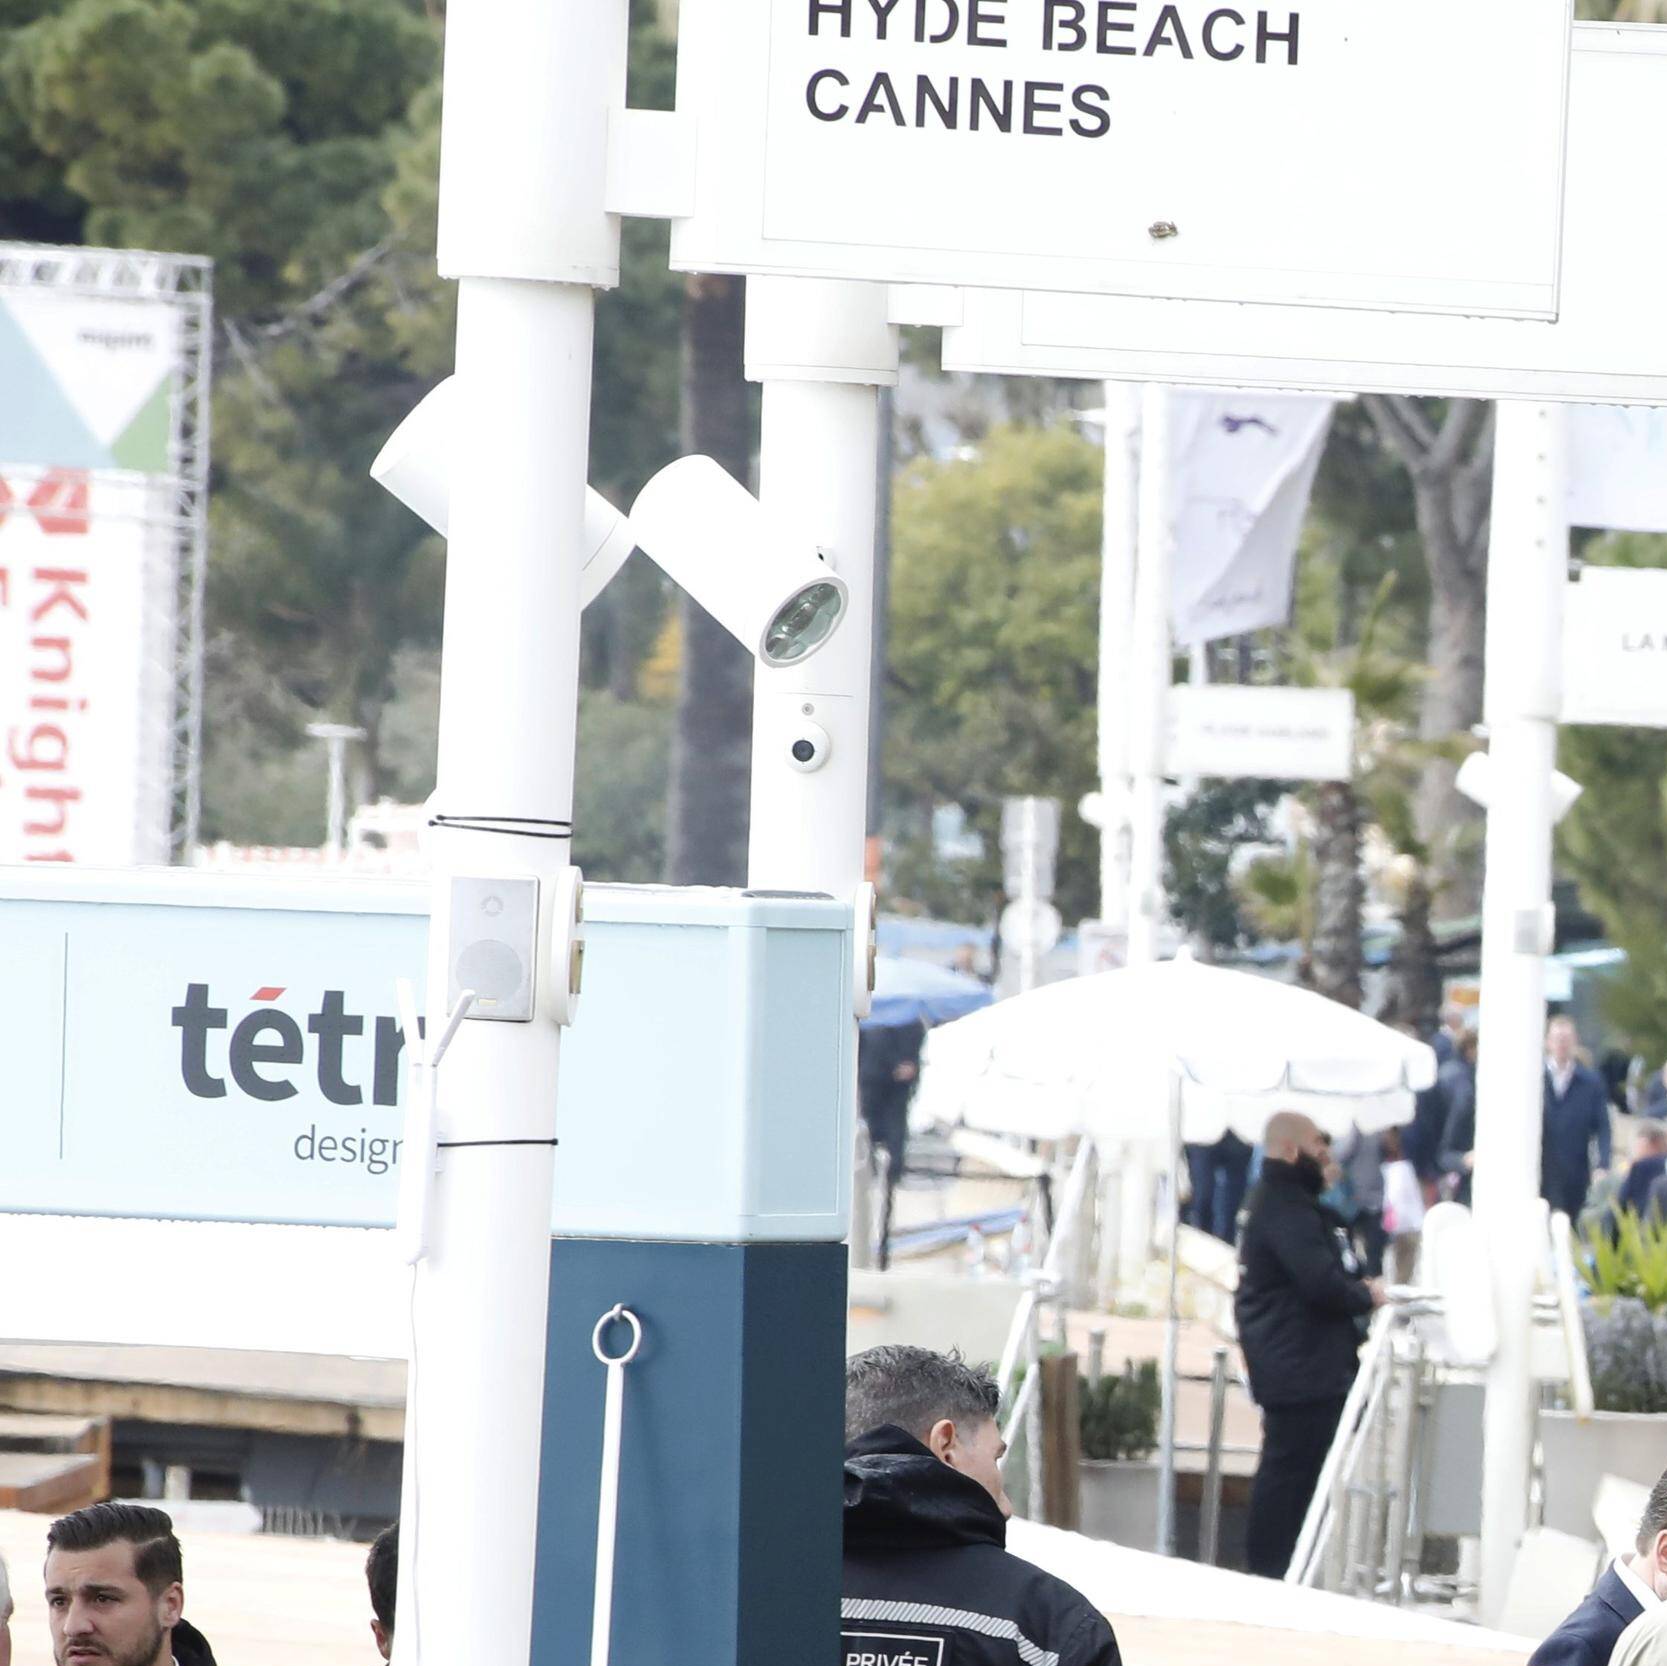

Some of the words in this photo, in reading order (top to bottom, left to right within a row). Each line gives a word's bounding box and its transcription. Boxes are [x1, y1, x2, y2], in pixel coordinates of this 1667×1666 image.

[808, 0, 1008, 48] HYDE
[1042, 0, 1300, 66] BEACH
[806, 69, 1111, 138] CANNES
[1621, 632, 1654, 652] LA
[171, 983, 426, 1106] tétr
